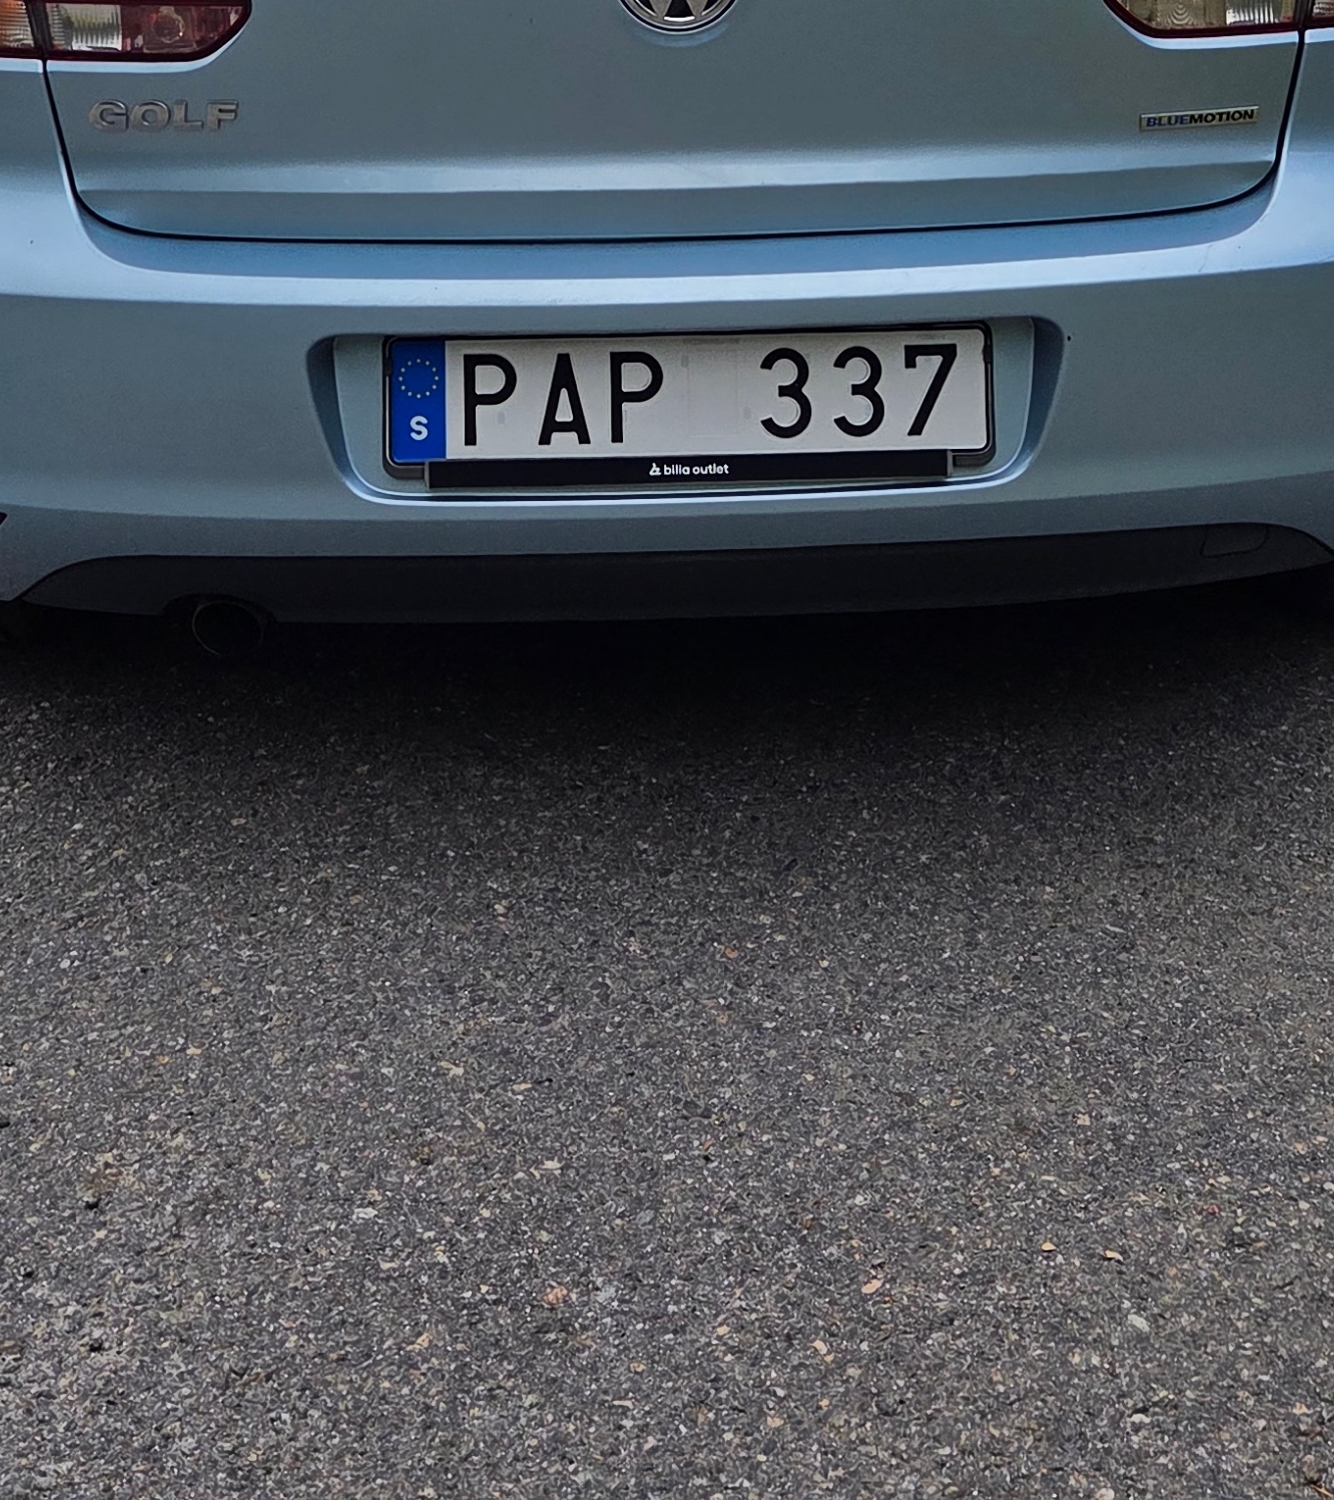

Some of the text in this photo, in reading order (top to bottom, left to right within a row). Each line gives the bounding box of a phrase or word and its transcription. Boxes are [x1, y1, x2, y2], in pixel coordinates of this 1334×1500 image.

[88, 99, 239, 132] GOLF
[1146, 109, 1255, 127] BLUEMOTION
[463, 343, 958, 446] PAP 337
[410, 415, 429, 440] S
[663, 463, 729, 475] bilia outlet
